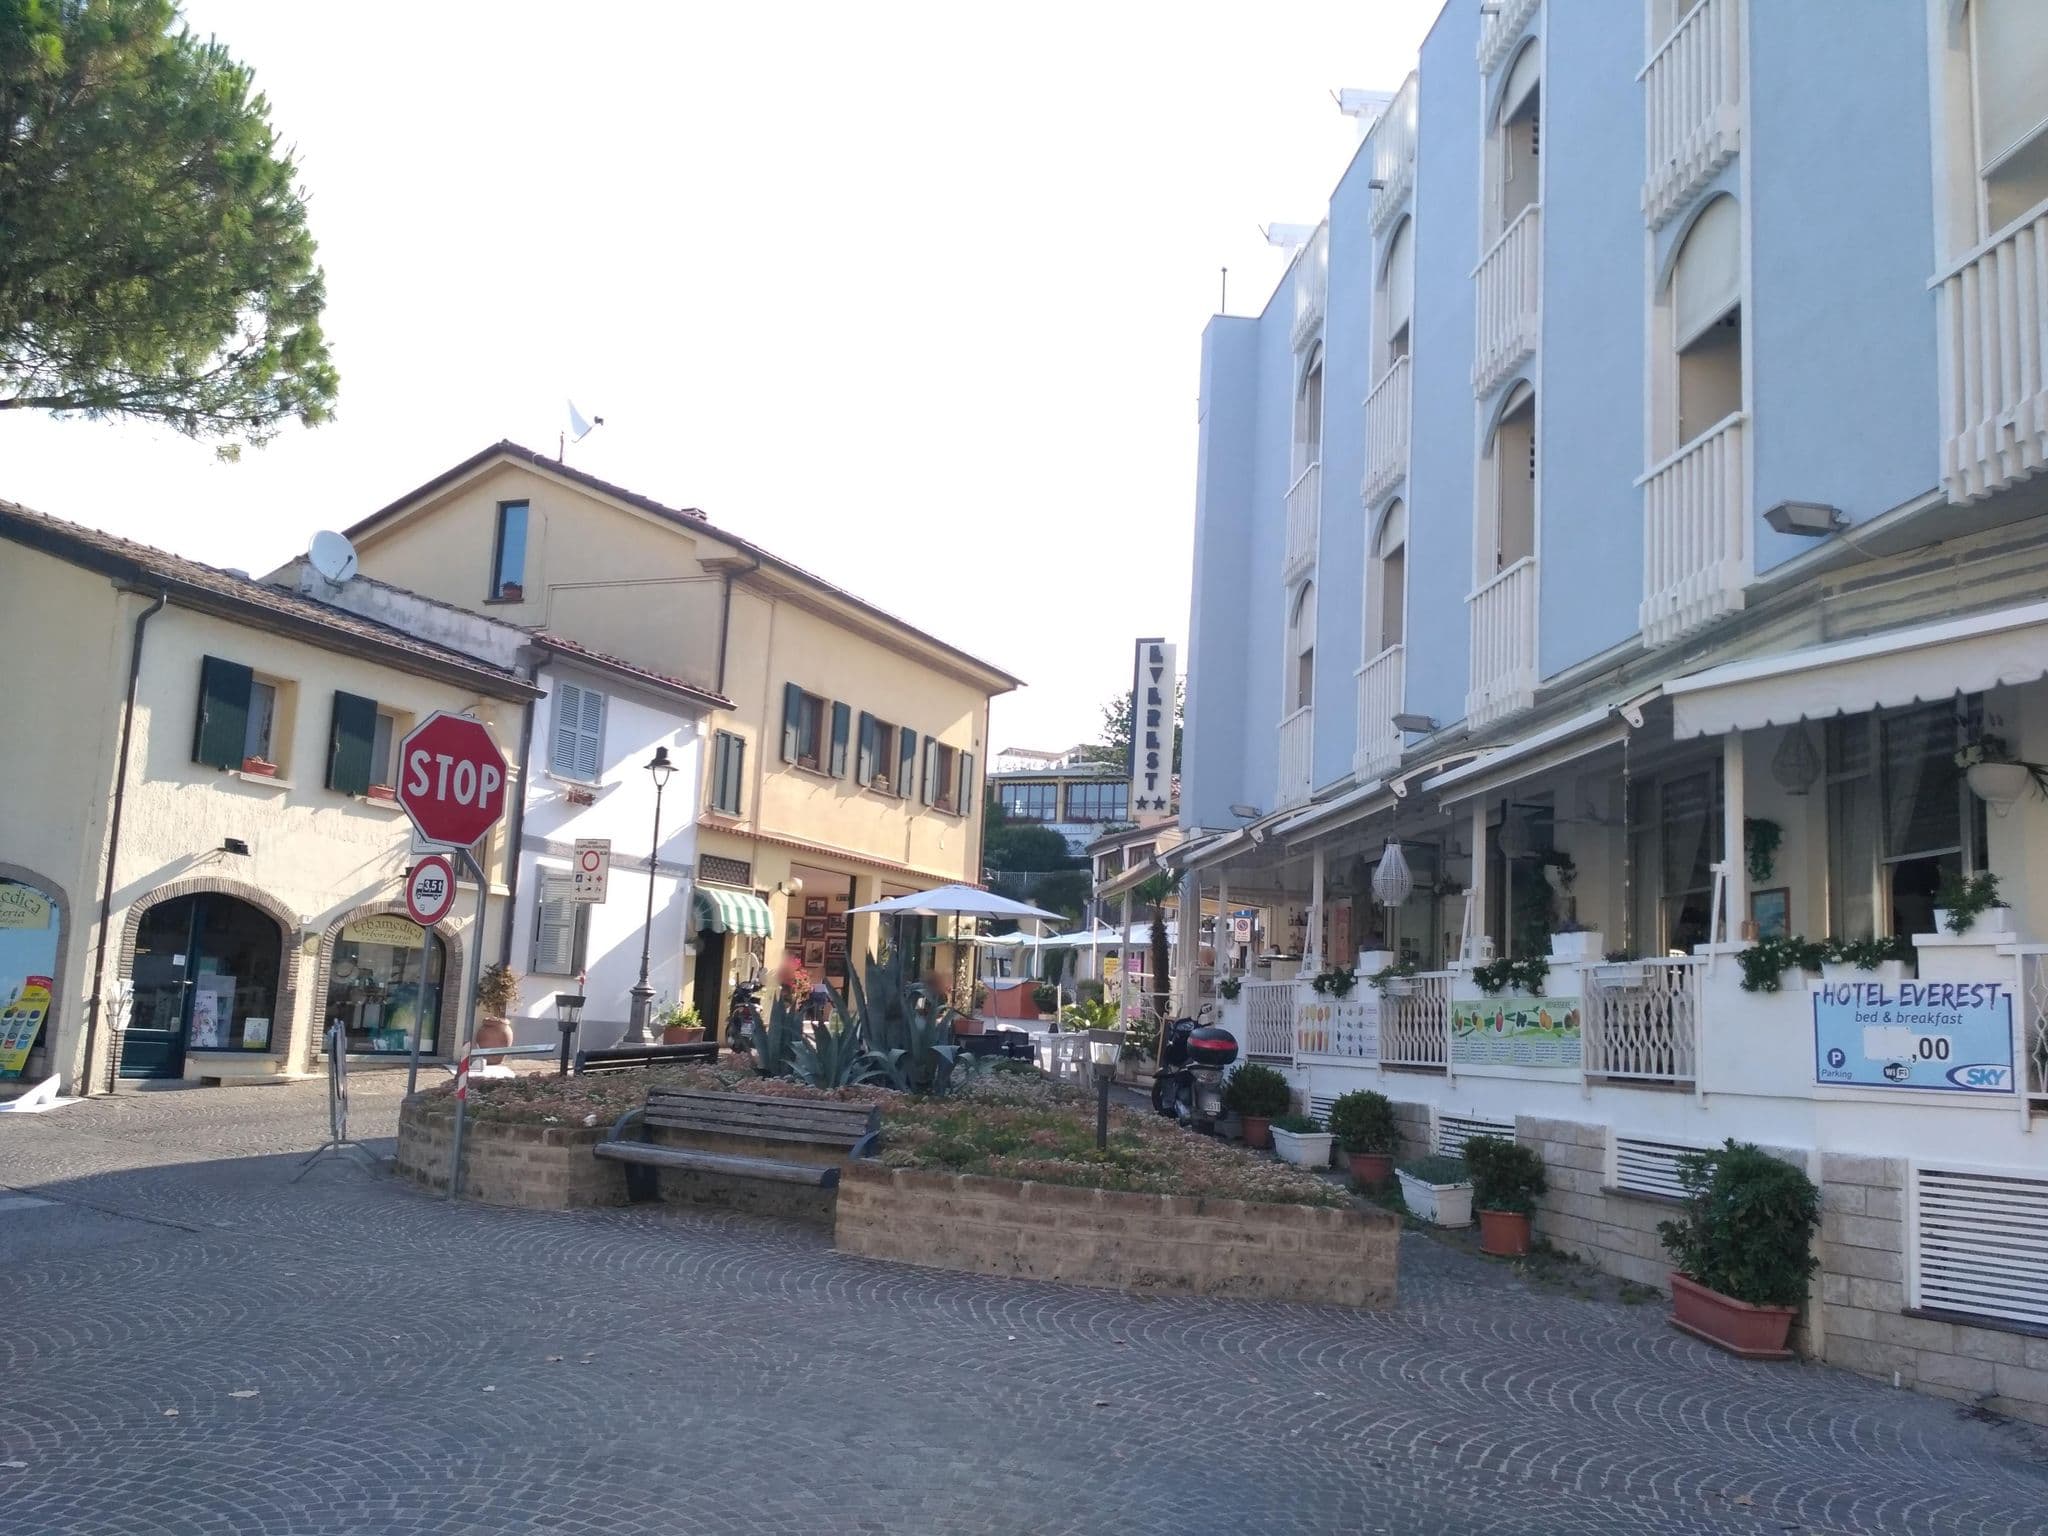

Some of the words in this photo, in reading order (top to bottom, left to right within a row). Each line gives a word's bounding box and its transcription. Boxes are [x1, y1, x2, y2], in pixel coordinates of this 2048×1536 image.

[1145, 645, 1164, 791] EVEREST
[408, 749, 500, 809] STOP
[0, 889, 41, 914] edica
[352, 920, 422, 940] Erbamedica
[1823, 983, 1895, 1008] HOTEL
[1900, 983, 2002, 1010] EVEREST
[1855, 1011, 1878, 1024] bed
[1882, 1014, 1892, 1024] &
[1896, 1011, 1964, 1026] breakfast
[1821, 1069, 1853, 1080] Parking
[1966, 1068, 2007, 1086] SKY
